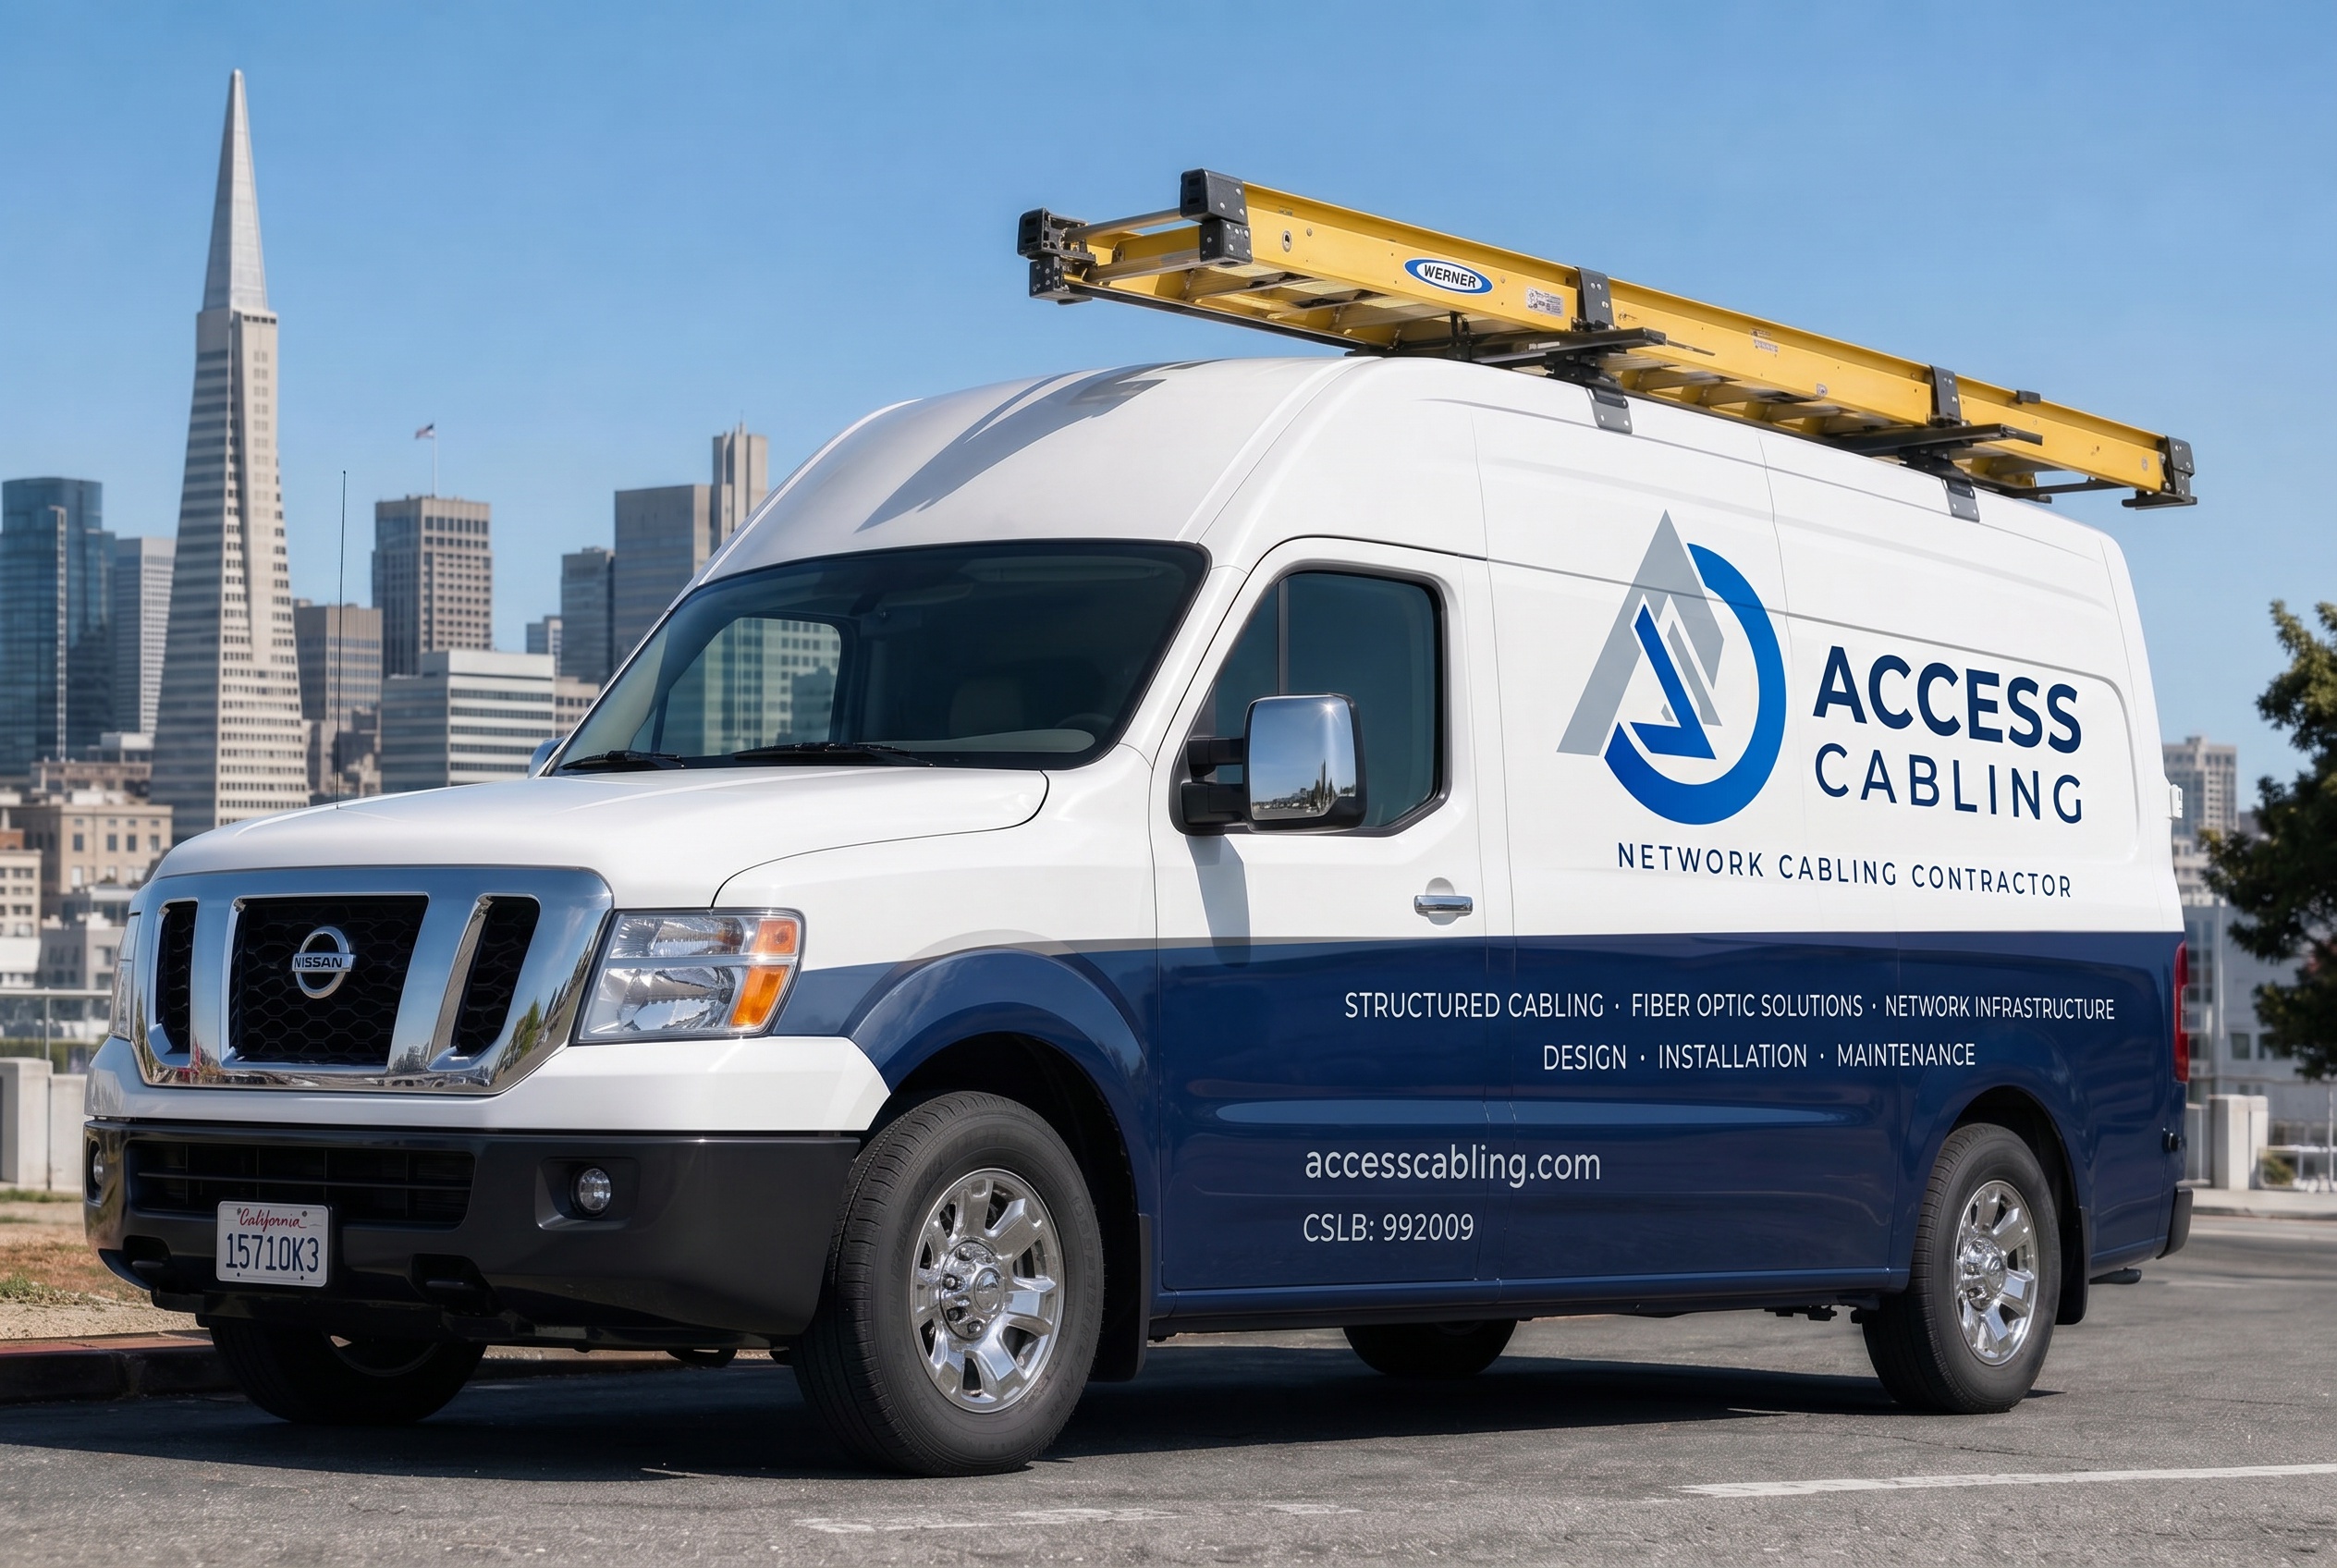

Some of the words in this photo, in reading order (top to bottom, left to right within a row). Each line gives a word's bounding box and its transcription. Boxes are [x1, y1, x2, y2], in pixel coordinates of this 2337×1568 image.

[1424, 263, 1476, 288] WERNER
[1813, 645, 2081, 753] ACCESS
[1816, 743, 2082, 824] CABLING
[1619, 843, 1763, 876] NETWORK
[1780, 855, 1895, 885] CABLING
[1913, 864, 2070, 897] CONTRACTOR
[294, 957, 342, 968] NISSAN
[1346, 992, 1499, 1018] STRUCTURED
[1509, 993, 1603, 1017] CABLING
[1633, 994, 1689, 1016] FIBER
[1697, 994, 1755, 1016] OPTIC
[1762, 994, 1862, 1016] SOLUTIONS
[1887, 996, 1970, 1016] NETWORK
[1976, 997, 2114, 1019] INFRASTRUCTURE
[1545, 1045, 1625, 1070] DESIGN
[1660, 1044, 1806, 1069] INSTALLATION
[1839, 1044, 1975, 1066] MAINTENANCE
[1306, 1145, 1599, 1188] accesscabling.com
[239, 1207, 307, 1232] California
[1304, 1214, 1374, 1242] CSLB:
[1384, 1214, 1474, 1241] 992009
